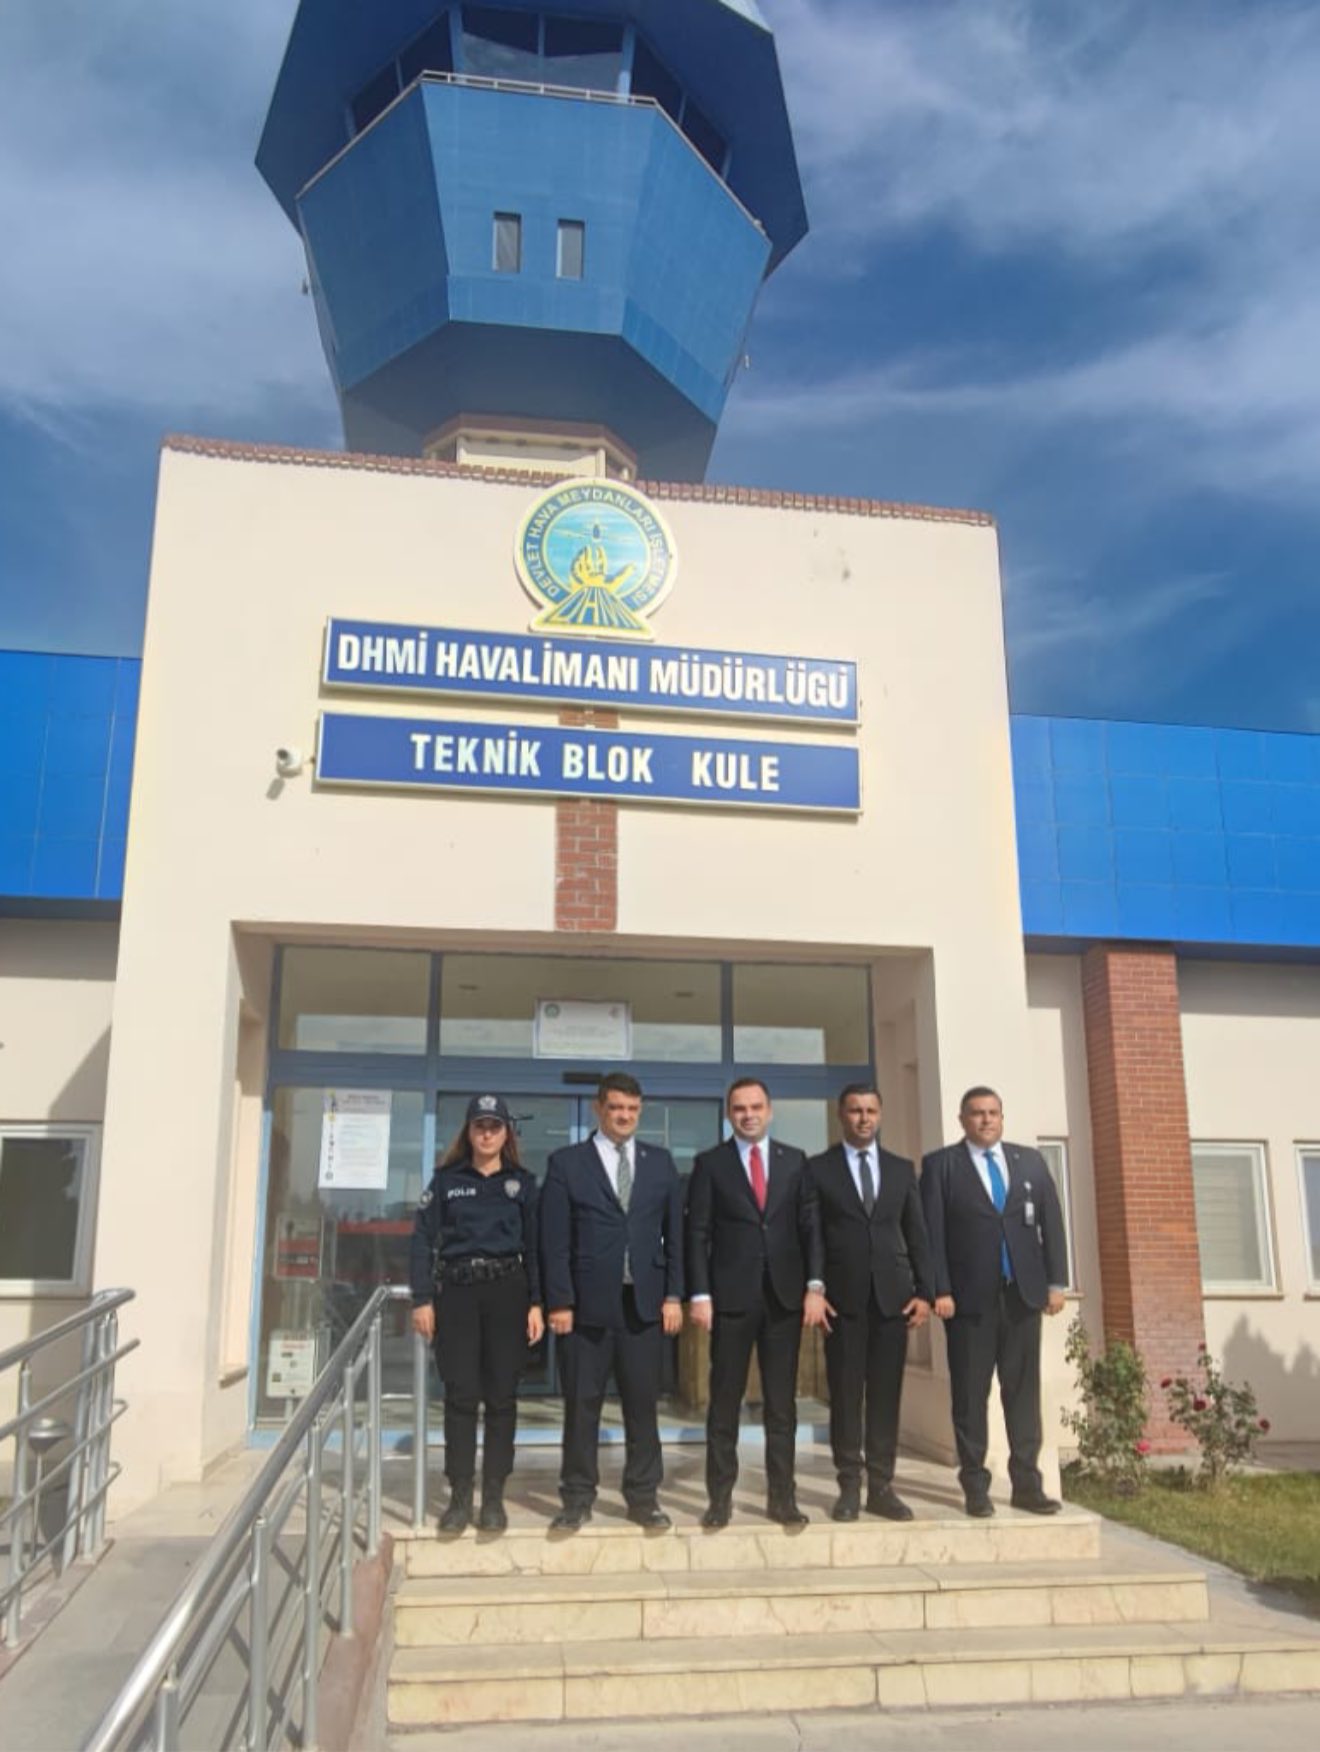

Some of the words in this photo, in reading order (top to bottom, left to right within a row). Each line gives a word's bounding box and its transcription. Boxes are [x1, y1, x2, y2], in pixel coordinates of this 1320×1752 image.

[529, 503, 559, 538] HAVA
[525, 542, 560, 598] DEVLET
[337, 631, 428, 676] DHMİ
[435, 641, 639, 691] HAVALİMANI
[410, 730, 541, 777] TEKNİK
[562, 743, 654, 783] BLOK
[691, 750, 780, 792] KULE
